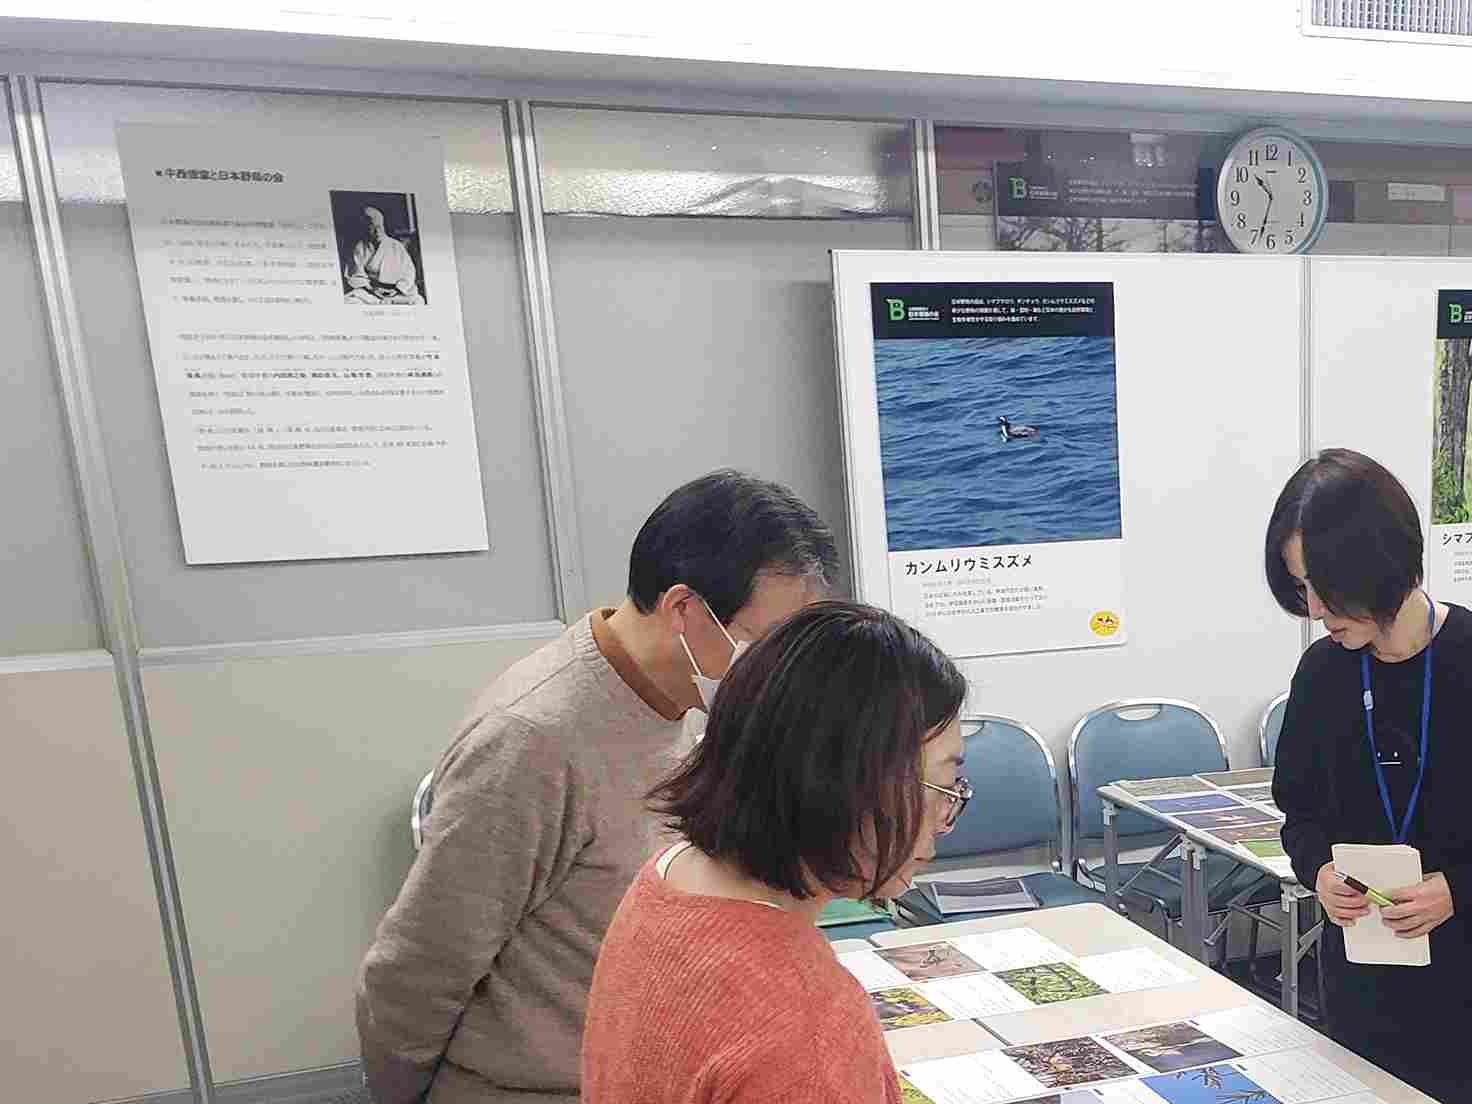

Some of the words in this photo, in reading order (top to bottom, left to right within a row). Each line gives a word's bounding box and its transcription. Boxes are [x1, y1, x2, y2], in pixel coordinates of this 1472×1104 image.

[1248, 150, 1259, 166] 11
[1265, 144, 1278, 160] 12
[1287, 150, 1292, 166] 1
[1235, 166, 1249, 183] 10
[1297, 167, 1306, 183] 2
[1008, 177, 1027, 199] B
[1230, 190, 1240, 206] 9
[1303, 190, 1312, 206] 3
[1236, 213, 1246, 229] 8
[1296, 211, 1304, 227] 4
[1250, 229, 1259, 245] 7
[1266, 233, 1275, 249] 6
[1284, 230, 1293, 245] 5
[886, 298, 905, 321] B
[1448, 304, 1462, 323] B
[905, 554, 1032, 576] カンムリウミスズメ
